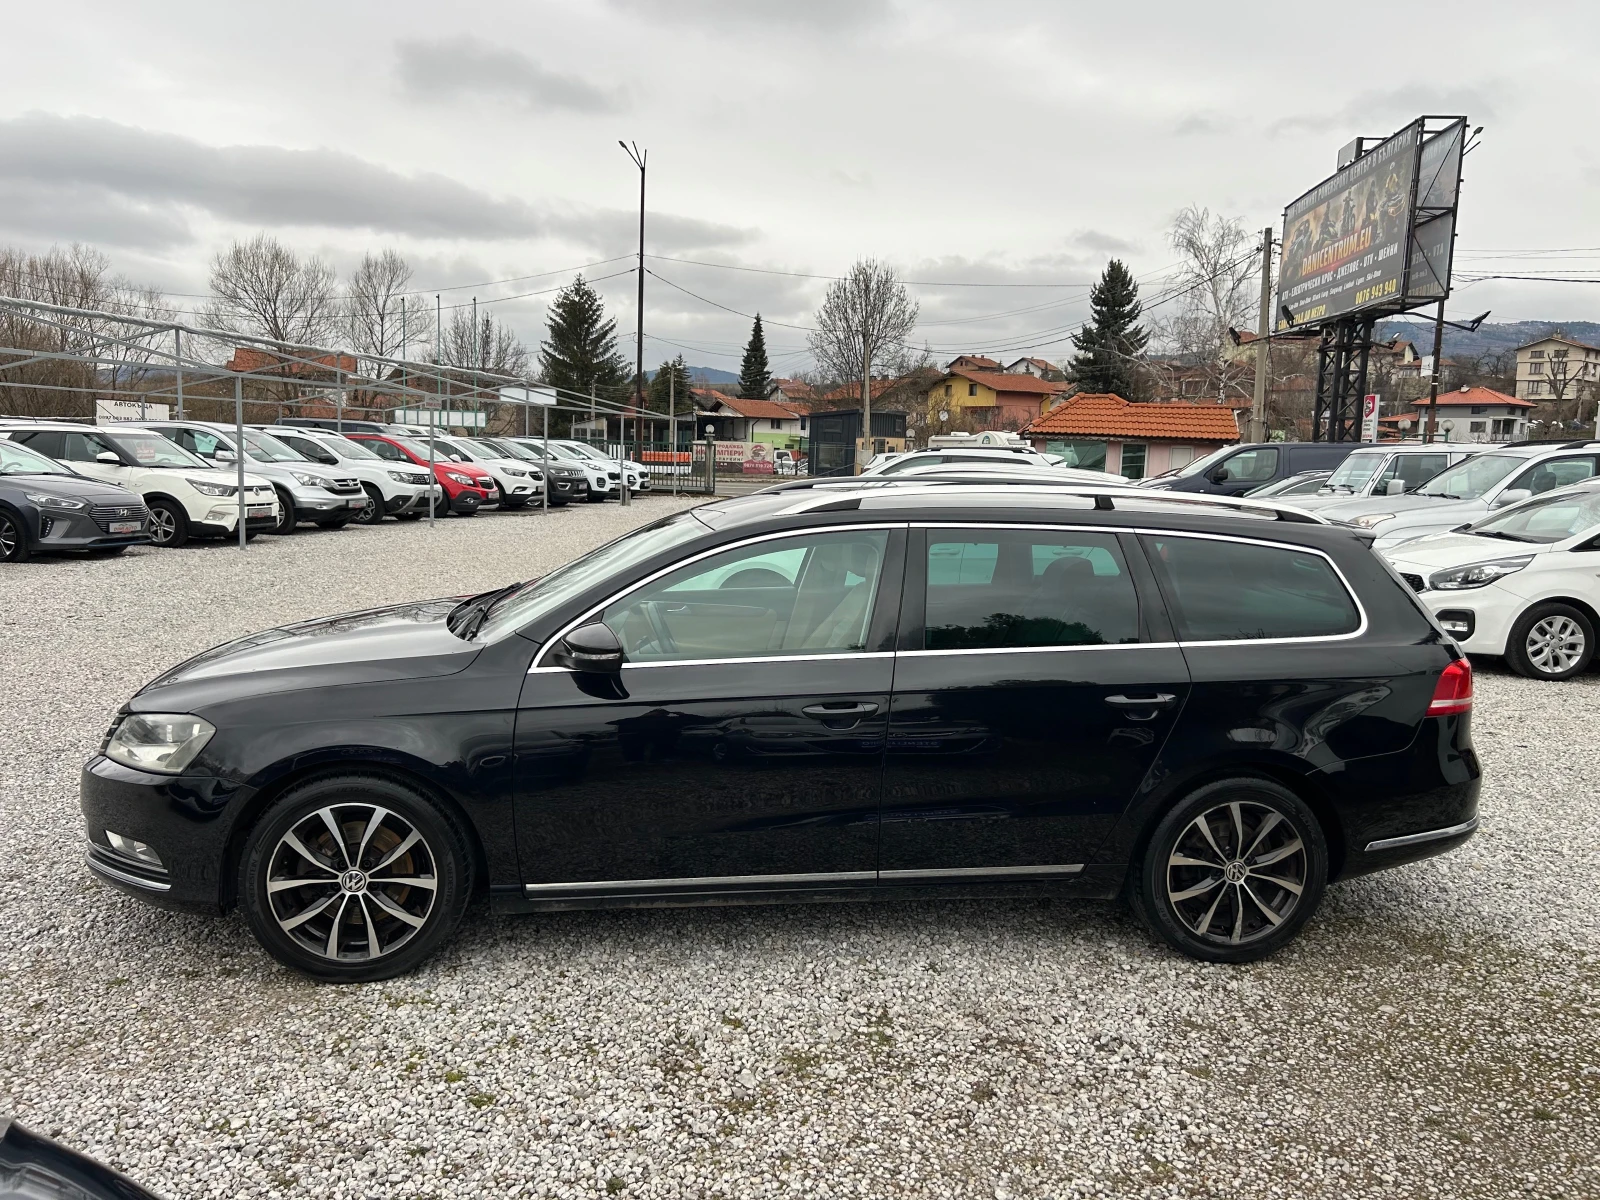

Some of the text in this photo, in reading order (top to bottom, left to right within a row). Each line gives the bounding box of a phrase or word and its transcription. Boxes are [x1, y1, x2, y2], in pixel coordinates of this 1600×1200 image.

[1350, 157, 1371, 182] ЦЕНТЪР
[1372, 152, 1377, 167] В
[1378, 129, 1412, 163] БЪЛГАРИЯ
[1302, 226, 1372, 276] DANICENTRUM.EU
[1291, 276, 1321, 297] ЕЛЕКТРИЧЕСКИ
[1321, 270, 1334, 285] КРОС
[1336, 259, 1360, 280] ДЖЕТОВЕ
[1363, 253, 1374, 268] UTV
[1371, 284, 1383, 300] 943
[1384, 278, 1397, 295] 940
[716, 449, 744, 457] МПЕРИ
[336, 786, 373, 794] ULTRAC
[248, 859, 258, 905] VREDESTEIN
[444, 861, 454, 907] VREDESTEIN
